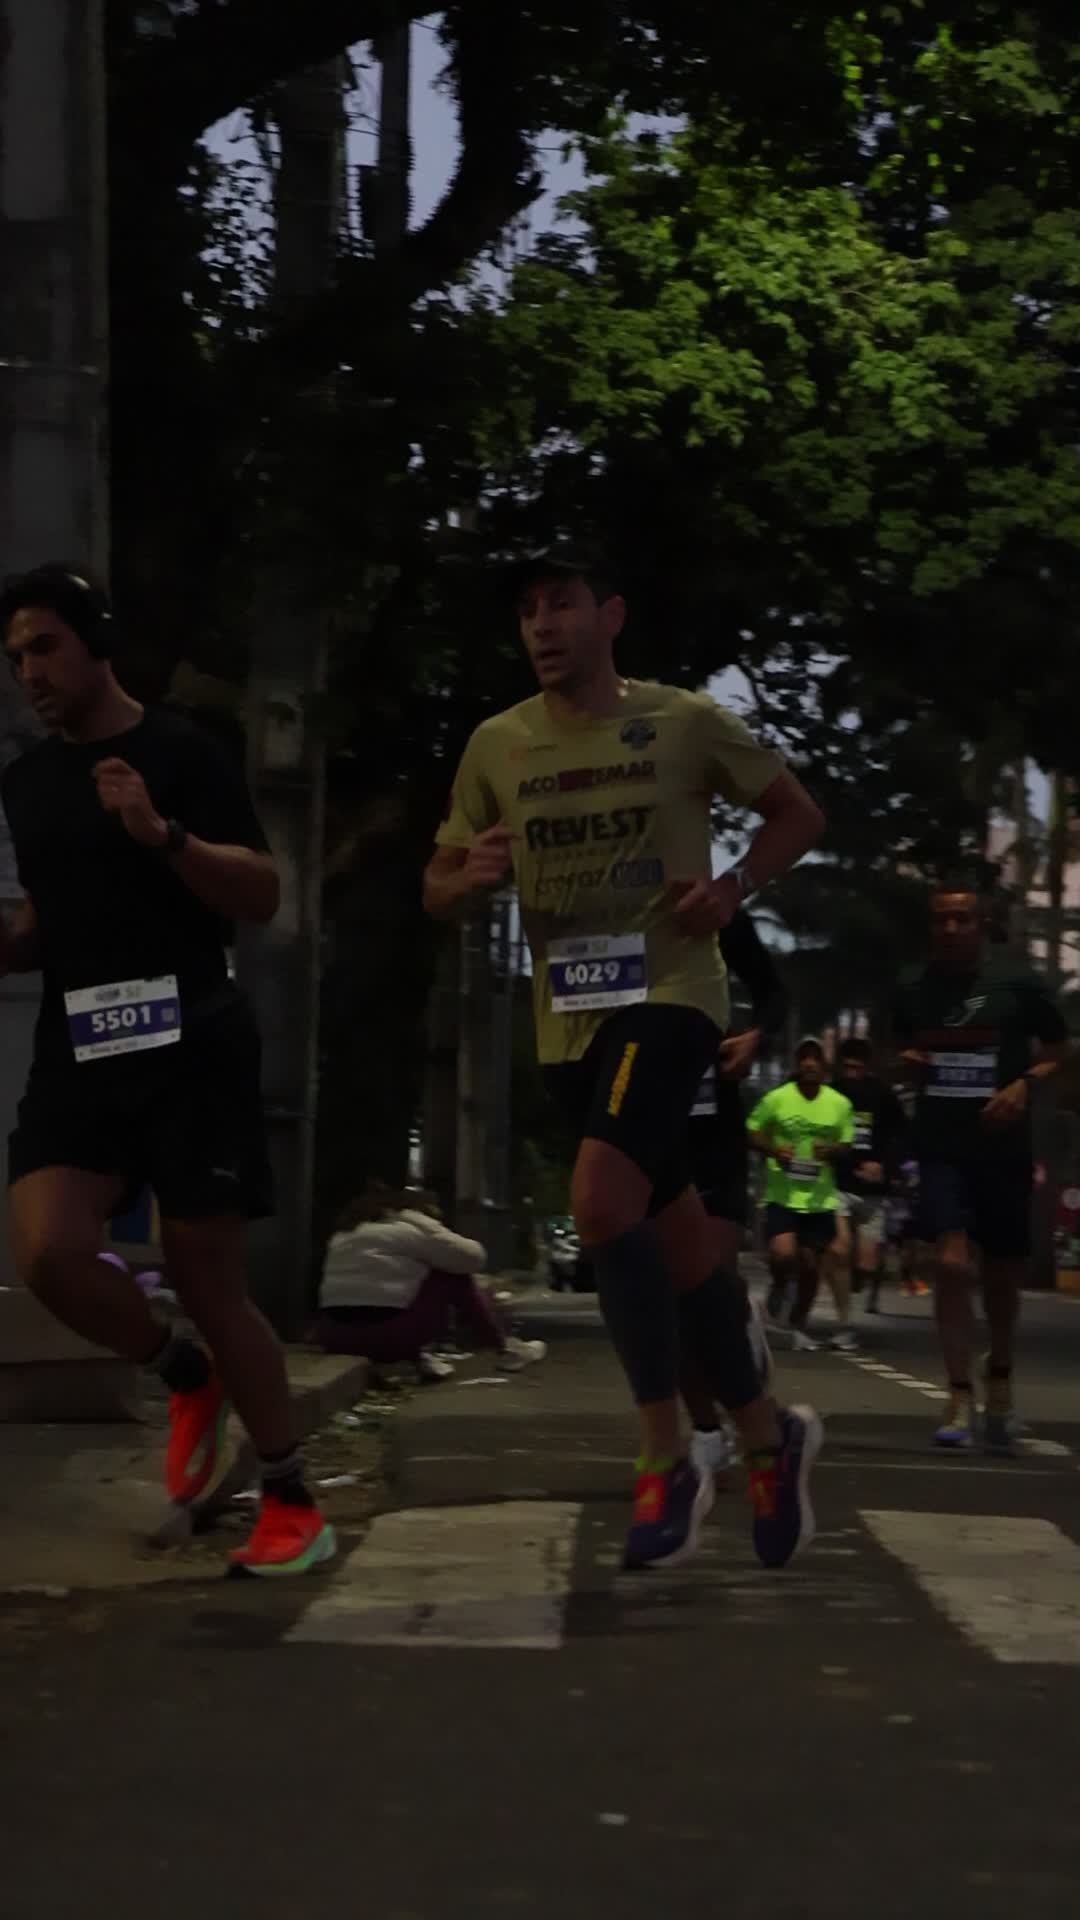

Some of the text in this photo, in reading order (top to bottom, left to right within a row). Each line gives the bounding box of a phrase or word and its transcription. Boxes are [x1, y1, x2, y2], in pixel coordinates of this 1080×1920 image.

[525, 806, 654, 850] REVEST
[565, 960, 621, 986] 6029
[91, 1005, 152, 1034] 5501
